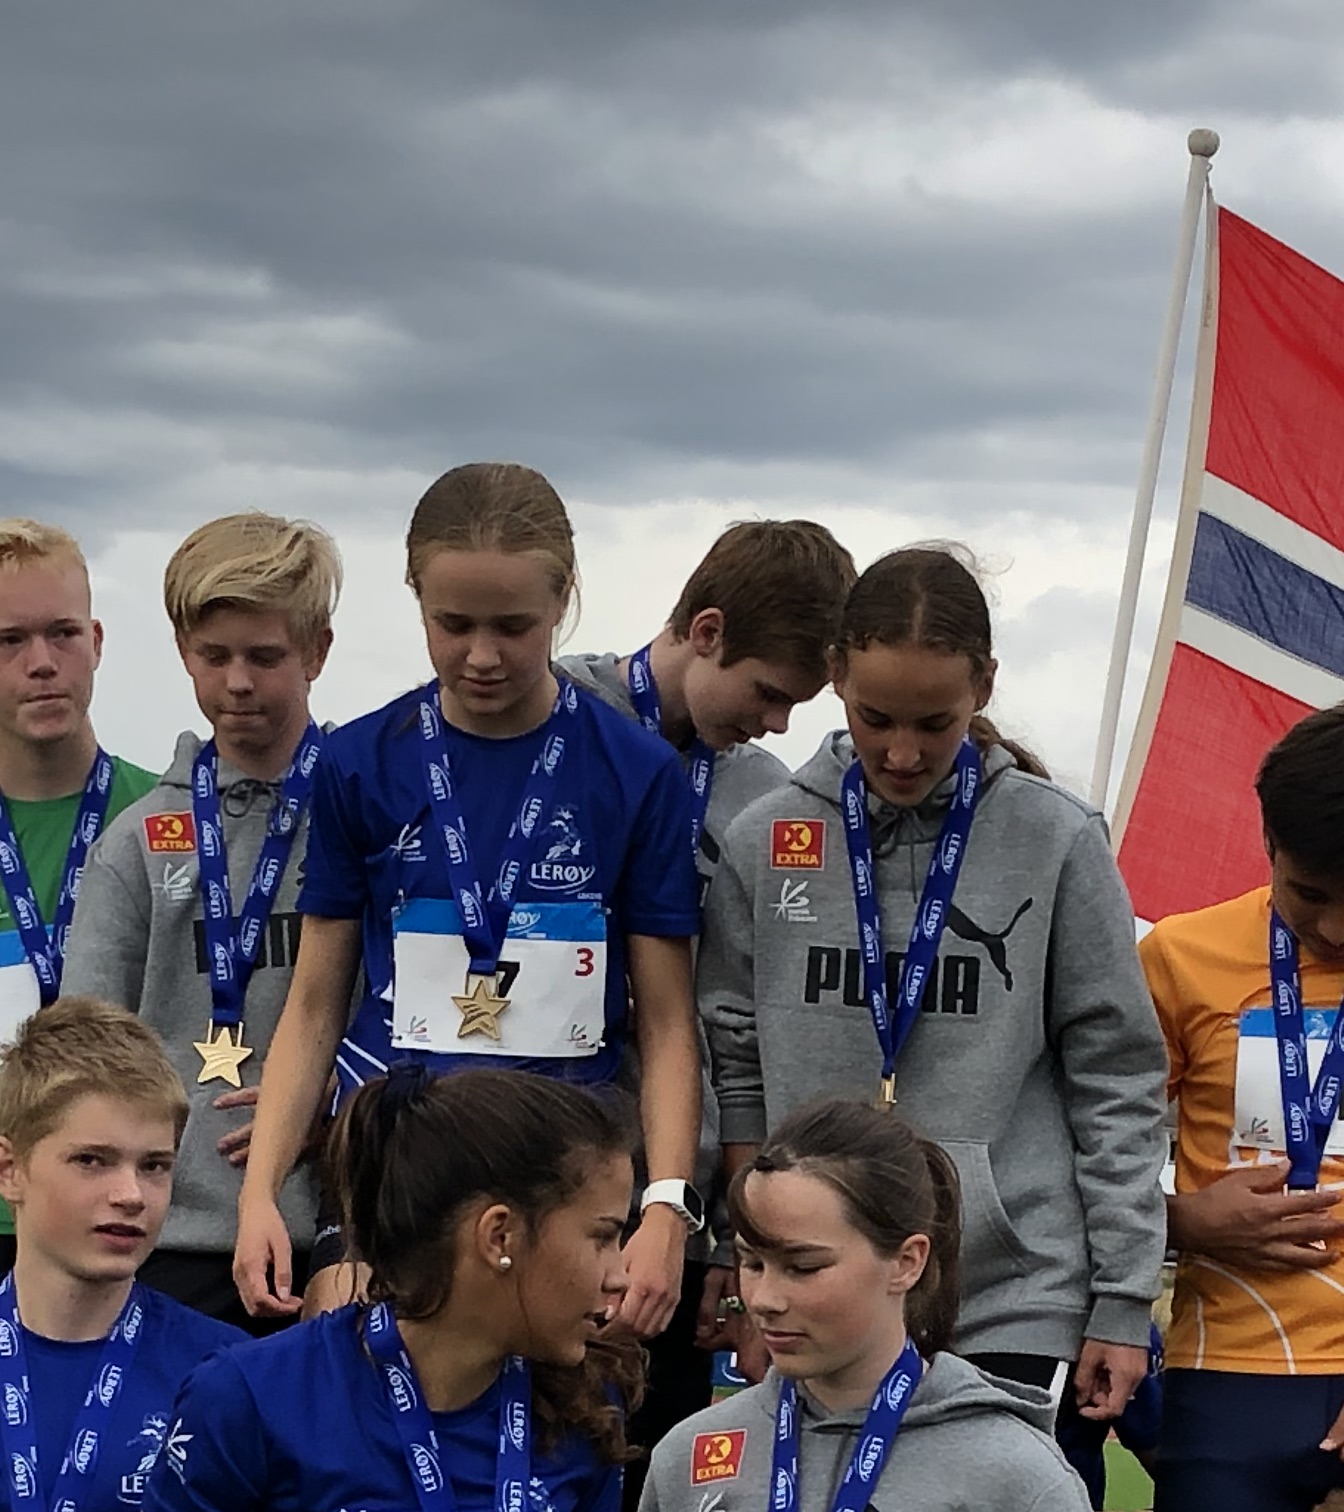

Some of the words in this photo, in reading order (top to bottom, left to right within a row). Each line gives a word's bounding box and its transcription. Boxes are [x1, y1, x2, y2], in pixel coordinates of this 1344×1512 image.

[152, 840, 194, 850] EXTRA
[776, 853, 819, 866] EXTRA
[530, 864, 594, 882] LERØY
[509, 912, 540, 925] RØY
[575, 948, 594, 976] 3
[696, 1464, 735, 1480] EXTRA
